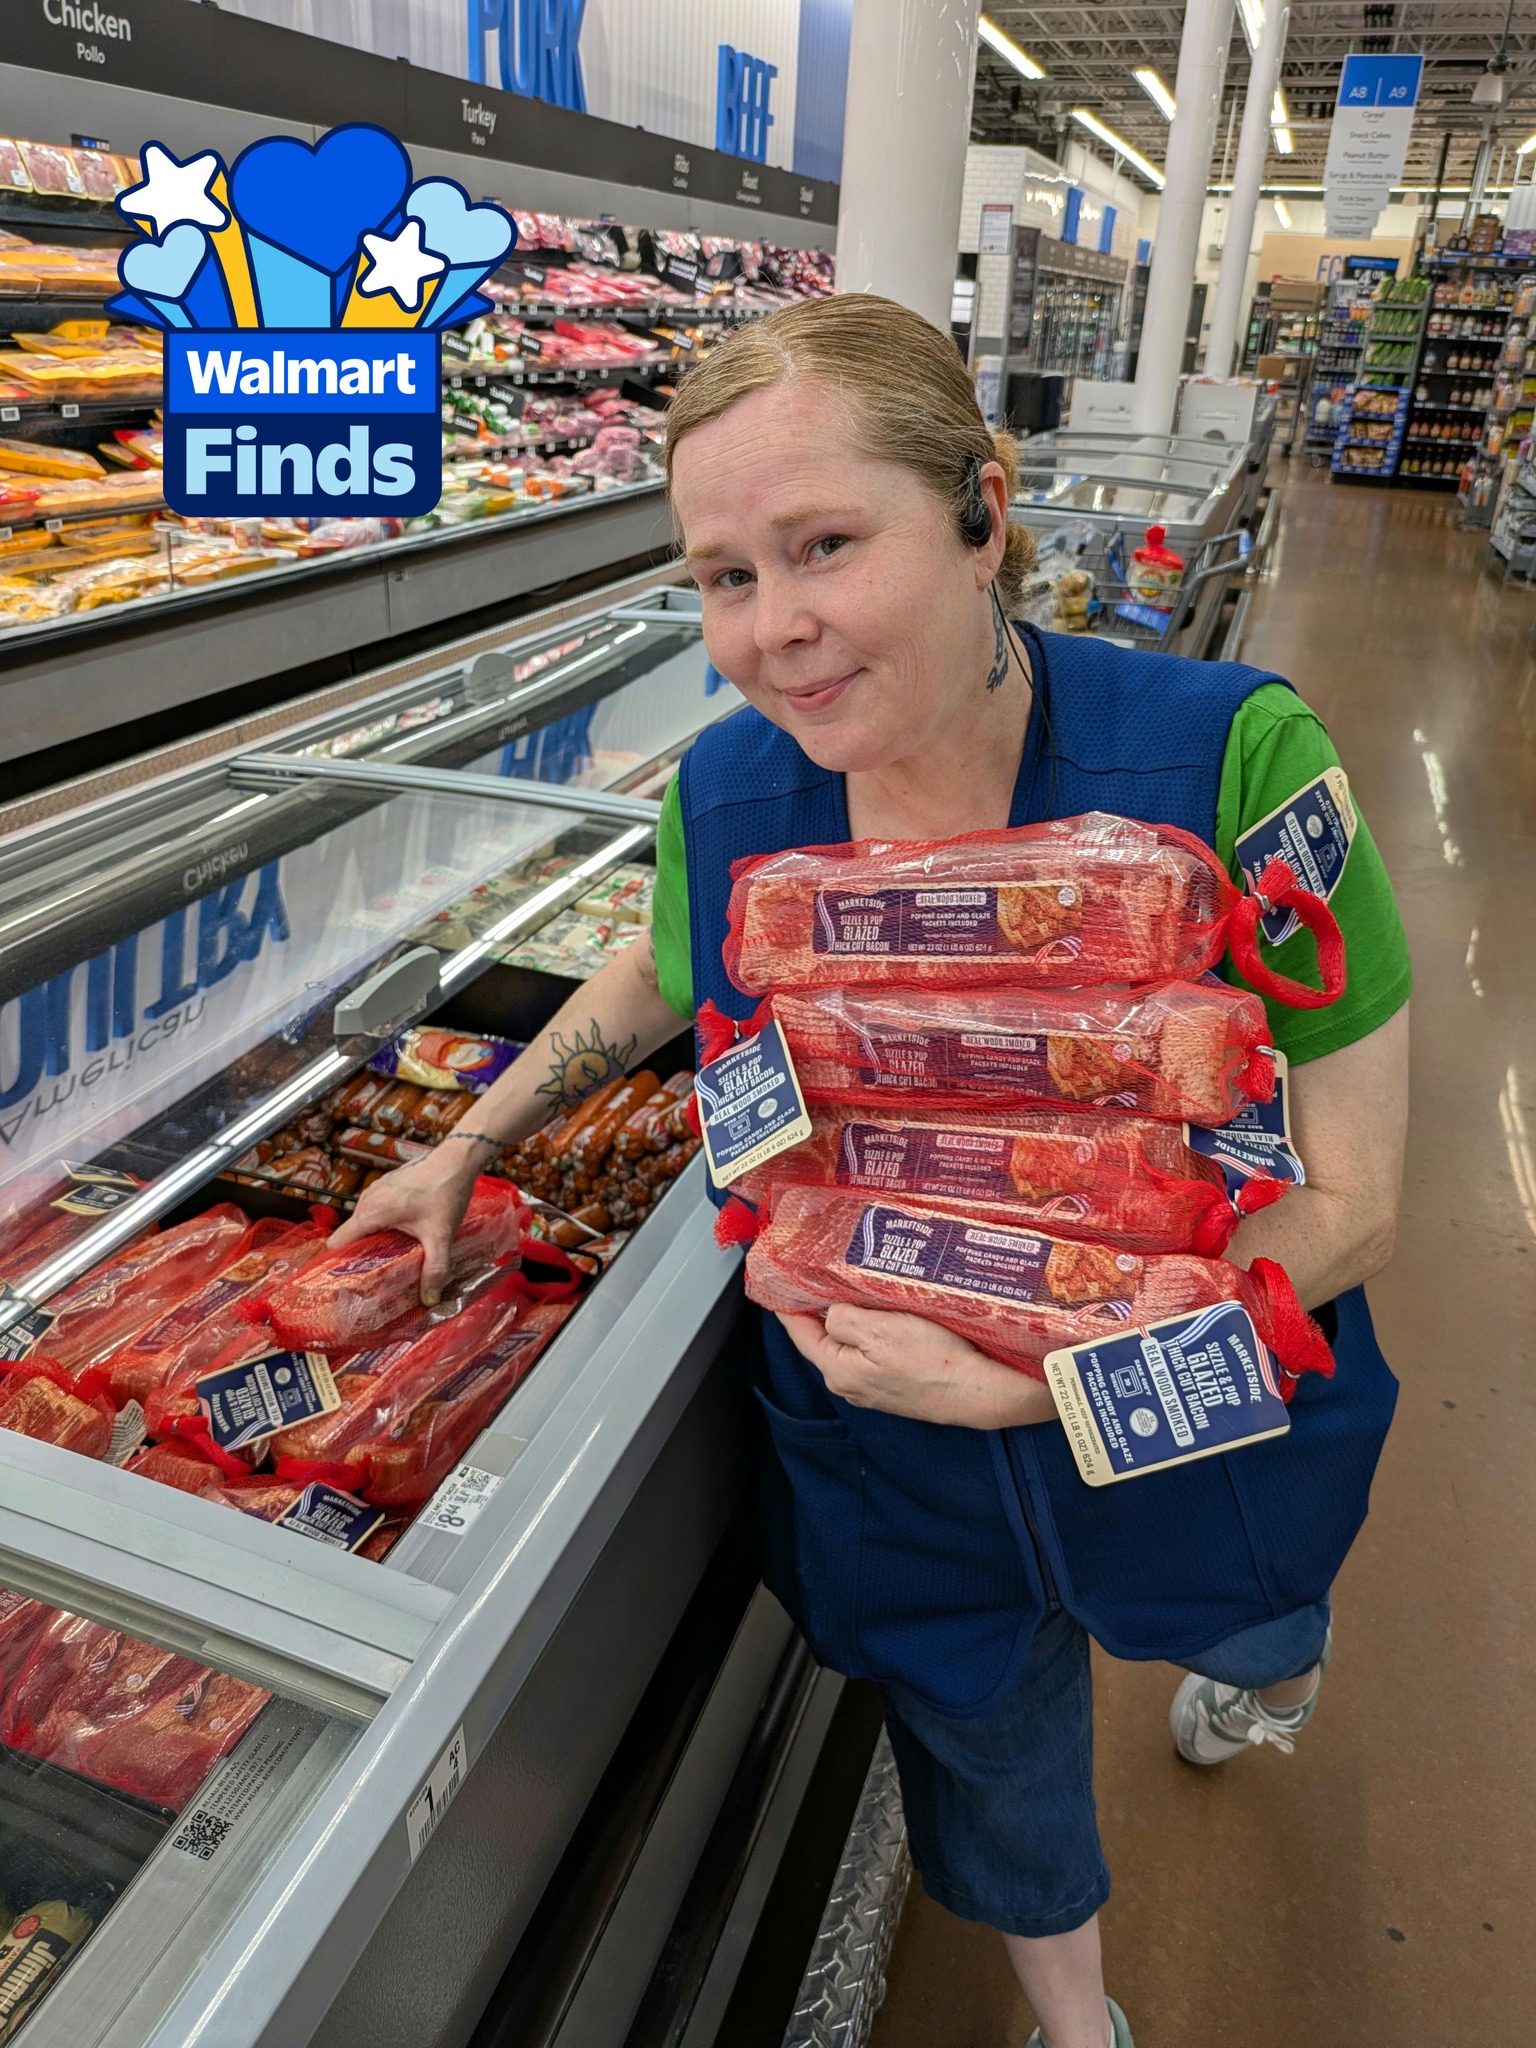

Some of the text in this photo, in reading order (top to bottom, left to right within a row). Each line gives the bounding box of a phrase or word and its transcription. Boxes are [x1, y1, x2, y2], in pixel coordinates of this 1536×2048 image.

[43, 0, 131, 41] Chicken
[77, 42, 105, 64] Pollo
[1349, 86, 1368, 98] A8
[1388, 86, 1408, 98] A9
[461, 98, 497, 135] Turkey
[1315, 789, 1325, 812] GLAZE
[1278, 827, 1294, 859] BACON
[1288, 817, 1321, 894] REAL WOOD SMOKED
[837, 898, 887, 911] MARKETSIDE
[843, 926, 879, 940] GLAZED
[715, 1043, 762, 1075] MARKETSIDE
[718, 1053, 762, 1086] SIZZLE & POP
[713, 1065, 774, 1110] THICK CUT BACON
[723, 1061, 760, 1095] GLAZED
[715, 1076, 779, 1122] REAL WOOD SMOKED
[716, 1106, 795, 1159] POPPING CANDY AND GLAZE
[731, 1119, 784, 1156] PACKETS INCLUDED
[722, 1173, 731, 1182] NET
[732, 1166, 739, 1174] WT
[748, 1156, 755, 1164] OZ
[763, 1147, 769, 1155] LB
[787, 1131, 797, 1141] 624
[1214, 1139, 1276, 1167] MARKETSIDE
[882, 1233, 905, 1245] SIZZLE
[911, 1239, 926, 1249] POP
[885, 1220, 934, 1237] MARKETSIDE
[879, 1244, 918, 1263] GLAZED
[885, 1260, 900, 1270] CUT
[900, 1264, 924, 1275] BACON
[1050, 1363, 1061, 1376] NET
[1055, 1377, 1065, 1388] WT
[1123, 1377, 1131, 1386] 30
[1133, 1359, 1144, 1375] BAKE
[1185, 1351, 1224, 1407] GLAZED
[1204, 1341, 1241, 1406] SIZZLE & POP
[1227, 1334, 1262, 1404] MARKETSIDE
[1059, 1390, 1068, 1400] 22
[1109, 1373, 1121, 1397] MINUTES
[1143, 1344, 1188, 1438] REAL WOOD SMOKED
[1164, 1340, 1209, 1429] THICK CUT BACON
[211, 1392, 231, 1434] MARKETSIDE
[234, 1386, 257, 1419] GLAZED
[1063, 1402, 1072, 1411] OZ
[1084, 1371, 1119, 1448] PACKETS INCLUDED
[1087, 1353, 1133, 1463] POPPING CANDY AND GLAZE
[1070, 1421, 1079, 1430] LB
[1079, 1408, 1087, 1419] KEEP
[1084, 1420, 1100, 1454] REFRIGERATED
[1077, 1439, 1087, 1451] OZ)
[1082, 1453, 1093, 1467] 624
[202, 1761, 240, 1806] REHAU-BEHR A/S
[210, 1780, 234, 1809] TEMPERED
[233, 1760, 250, 1779] SAFETY
[247, 1742, 263, 1759] GLASS
[224, 1773, 251, 1804] 12150/ANSI
[225, 1740, 284, 1817] PATENTED/PATENT PENDING
[424, 1785, 435, 1812] 1
